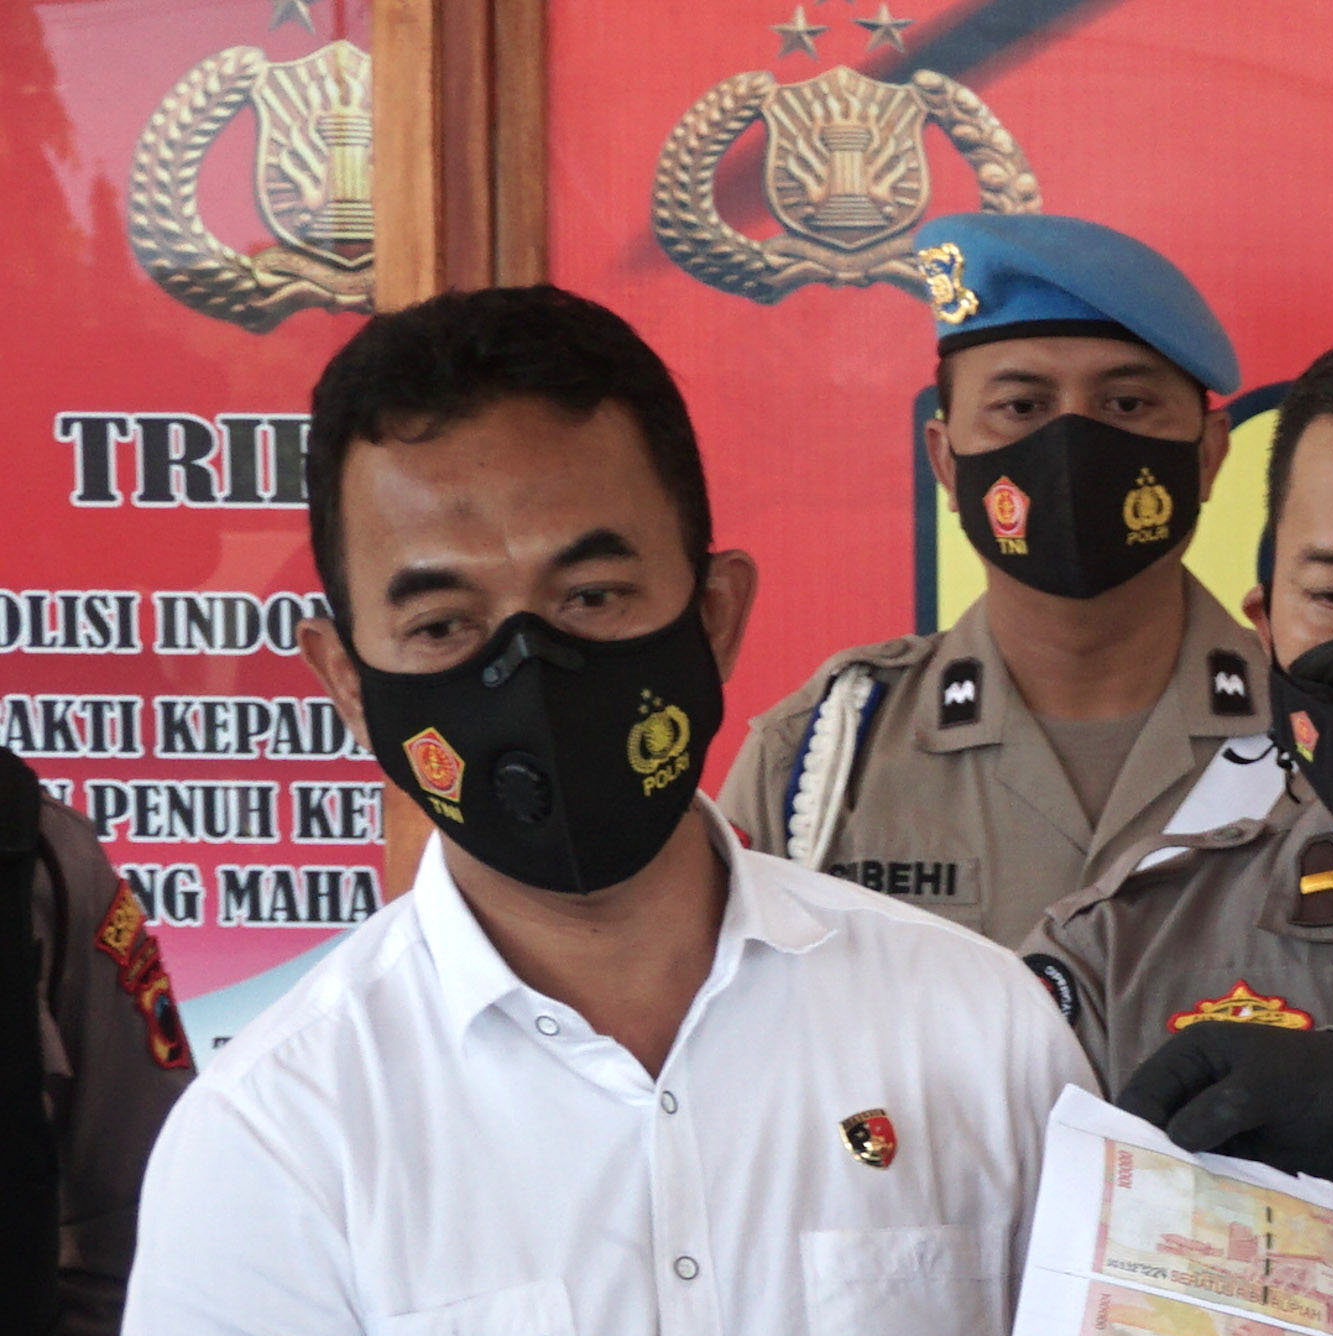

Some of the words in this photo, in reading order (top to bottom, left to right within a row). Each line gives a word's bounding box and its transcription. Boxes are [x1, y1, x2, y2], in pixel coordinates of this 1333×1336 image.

[642, 754, 690, 796] POLRI
[88, 782, 278, 843] PENUH
[217, 866, 385, 926] MAHA
